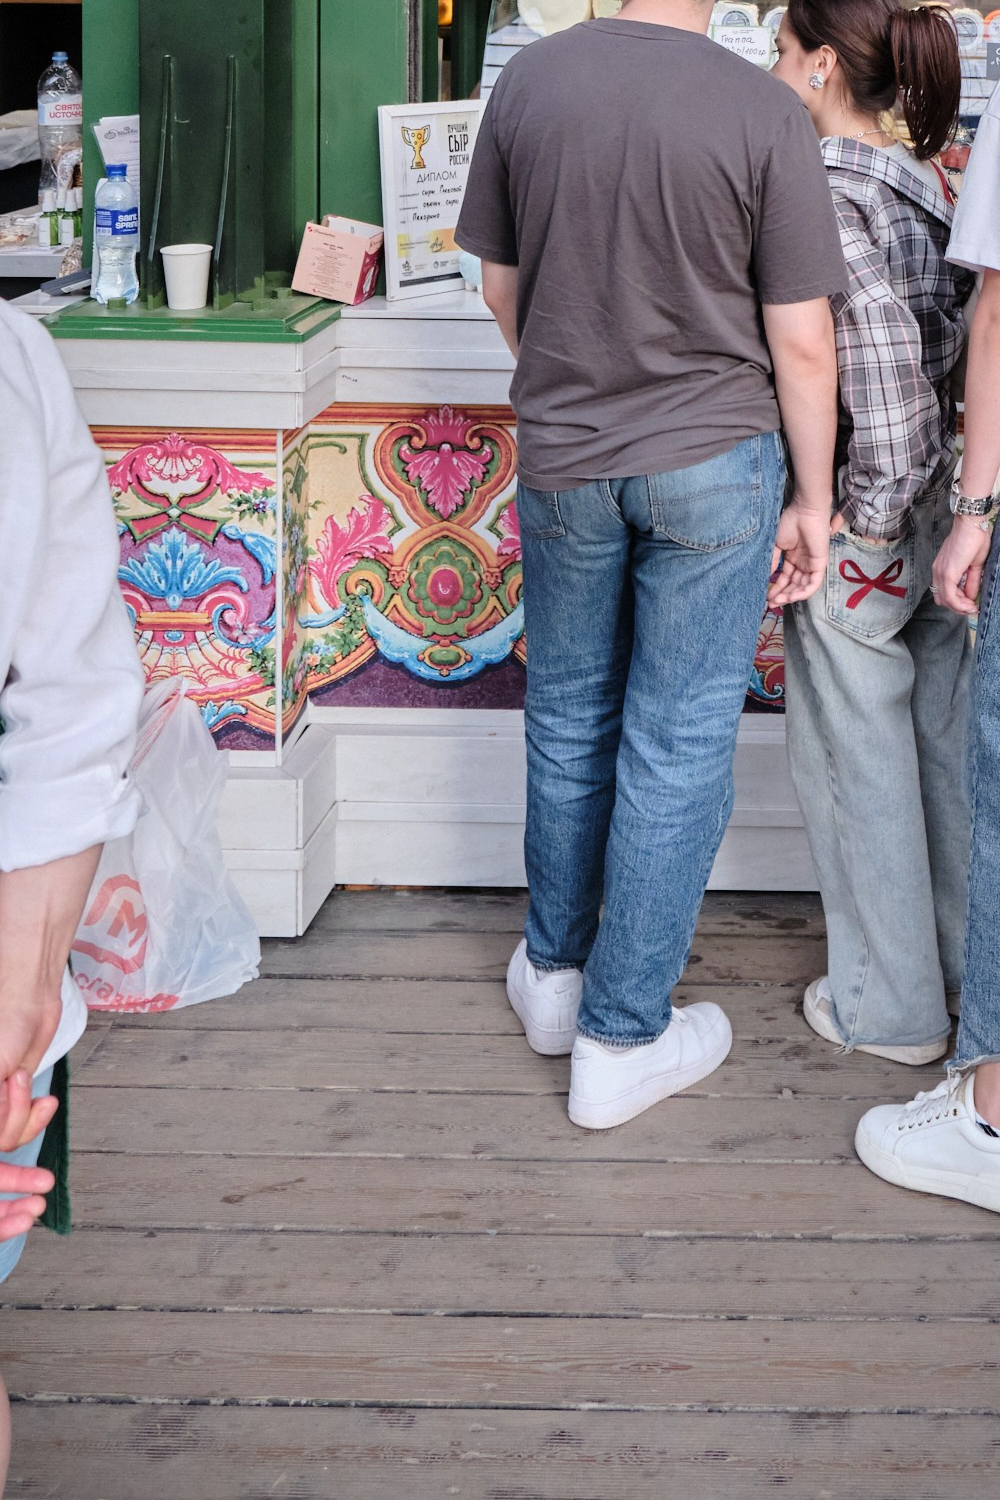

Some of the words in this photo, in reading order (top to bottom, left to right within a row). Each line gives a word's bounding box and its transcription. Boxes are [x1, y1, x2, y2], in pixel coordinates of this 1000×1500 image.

[448, 134, 469, 152] СЫР
[449, 154, 470, 166] РОССИИ
[416, 170, 457, 184] ДИПЛОМ
